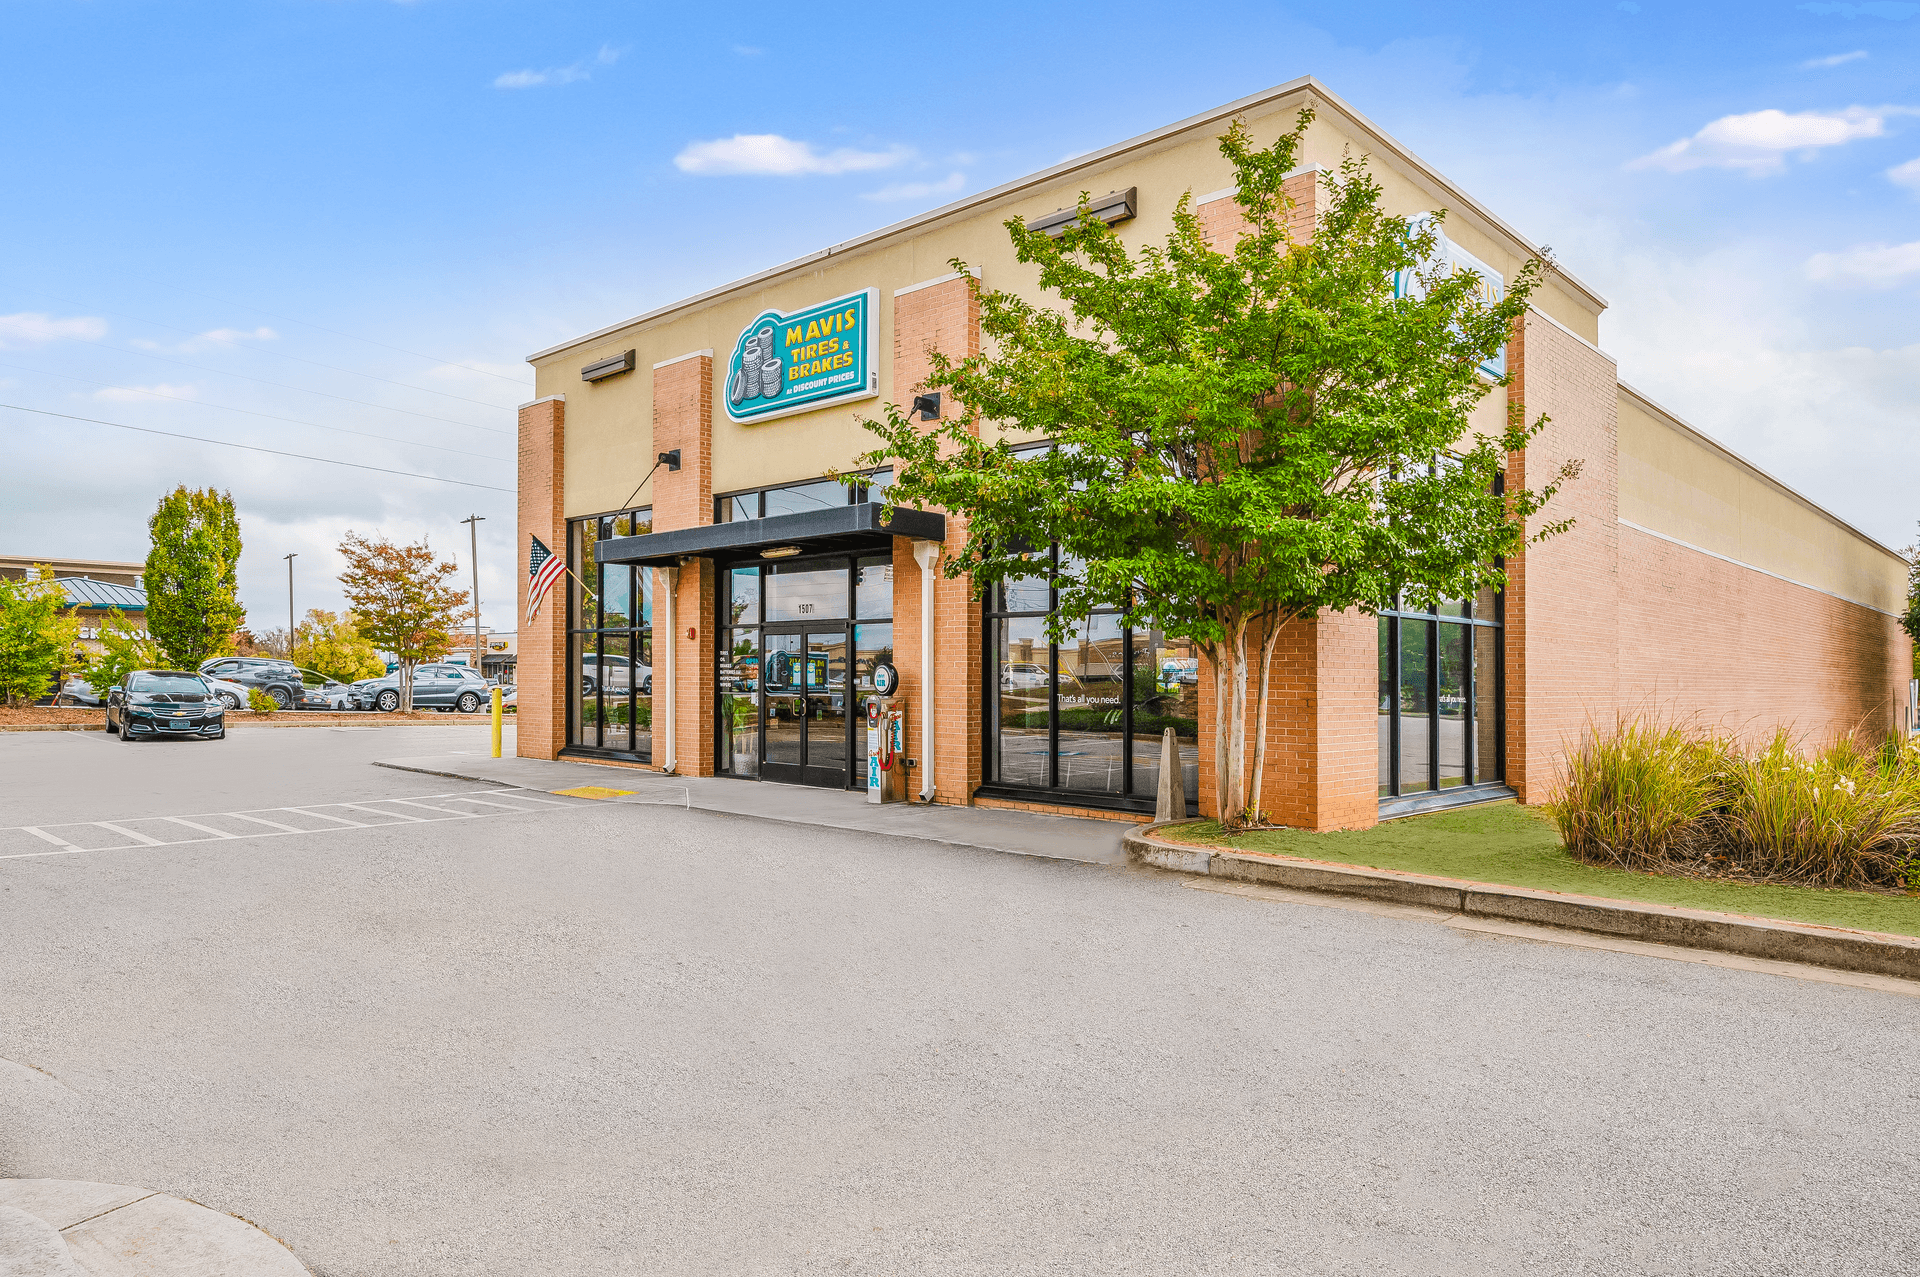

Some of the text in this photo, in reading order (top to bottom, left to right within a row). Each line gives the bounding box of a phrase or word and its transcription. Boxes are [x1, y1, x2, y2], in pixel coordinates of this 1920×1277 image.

[785, 308, 856, 348] MAVIS
[791, 337, 850, 363] TIRES &
[788, 351, 853, 381] BRAKES
[793, 377, 828, 393] DISCOUNT
[828, 370, 855, 384] PRICES
[798, 603, 813, 614] 1507
[1057, 693, 1077, 703] That's
[1086, 696, 1100, 706] you
[1100, 694, 1122, 705] need.
[869, 756, 880, 788] AIR
